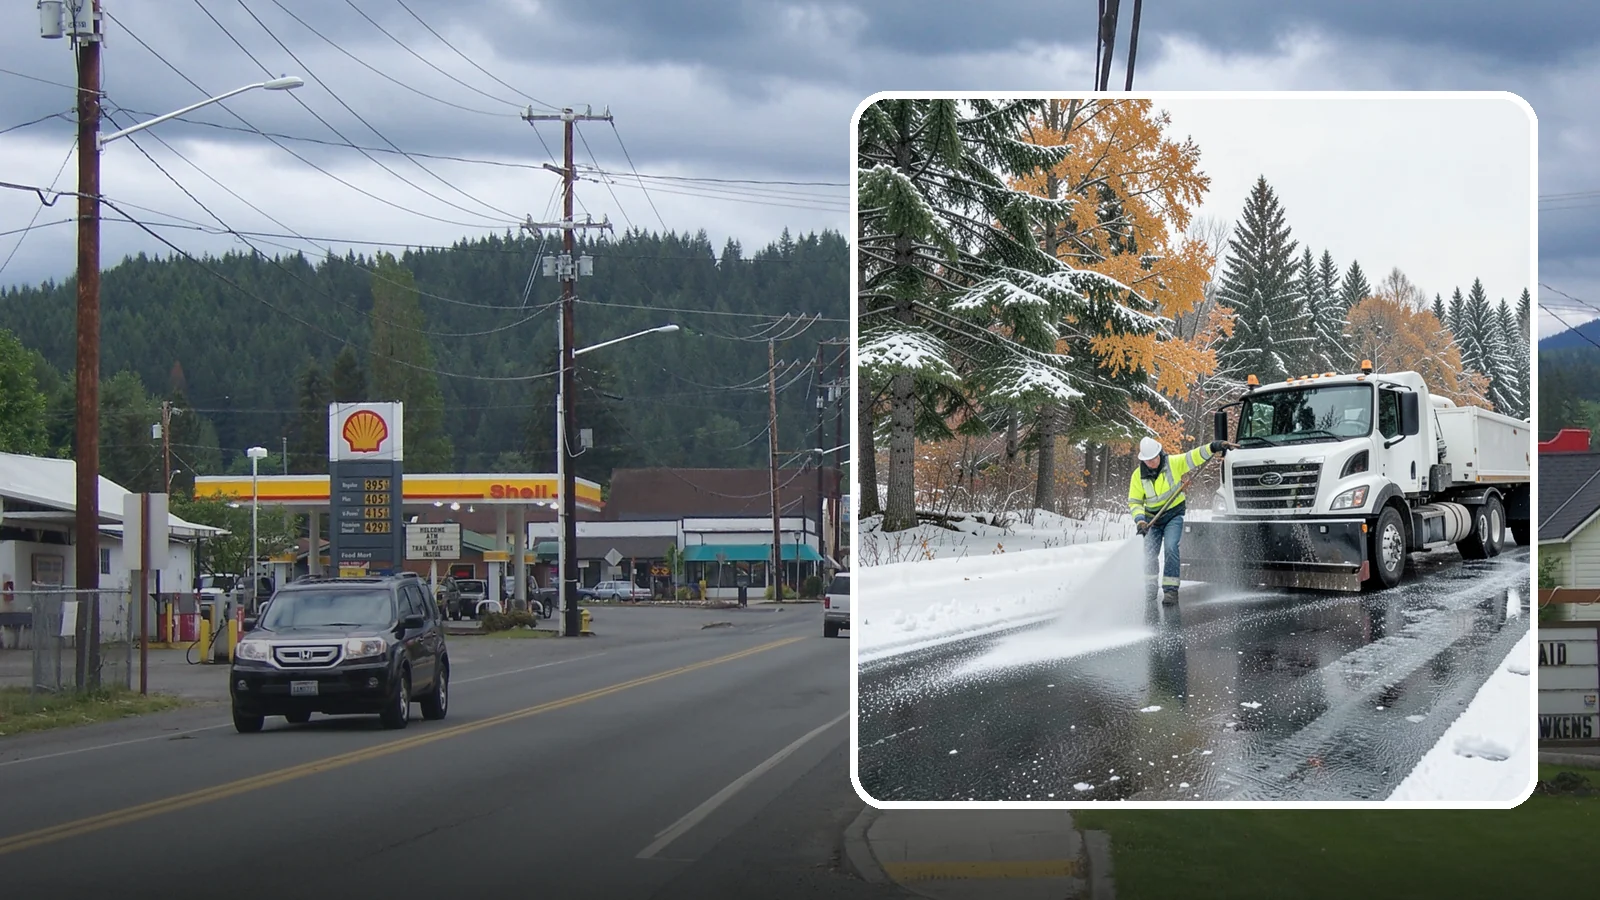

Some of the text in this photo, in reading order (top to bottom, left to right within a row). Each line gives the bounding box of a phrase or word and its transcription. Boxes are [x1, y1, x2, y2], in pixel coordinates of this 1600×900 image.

[365, 480, 383, 490] 395
[490, 484, 547, 499] Shell
[365, 494, 383, 504] 405
[365, 508, 383, 518] 415
[365, 522, 383, 533] 429
